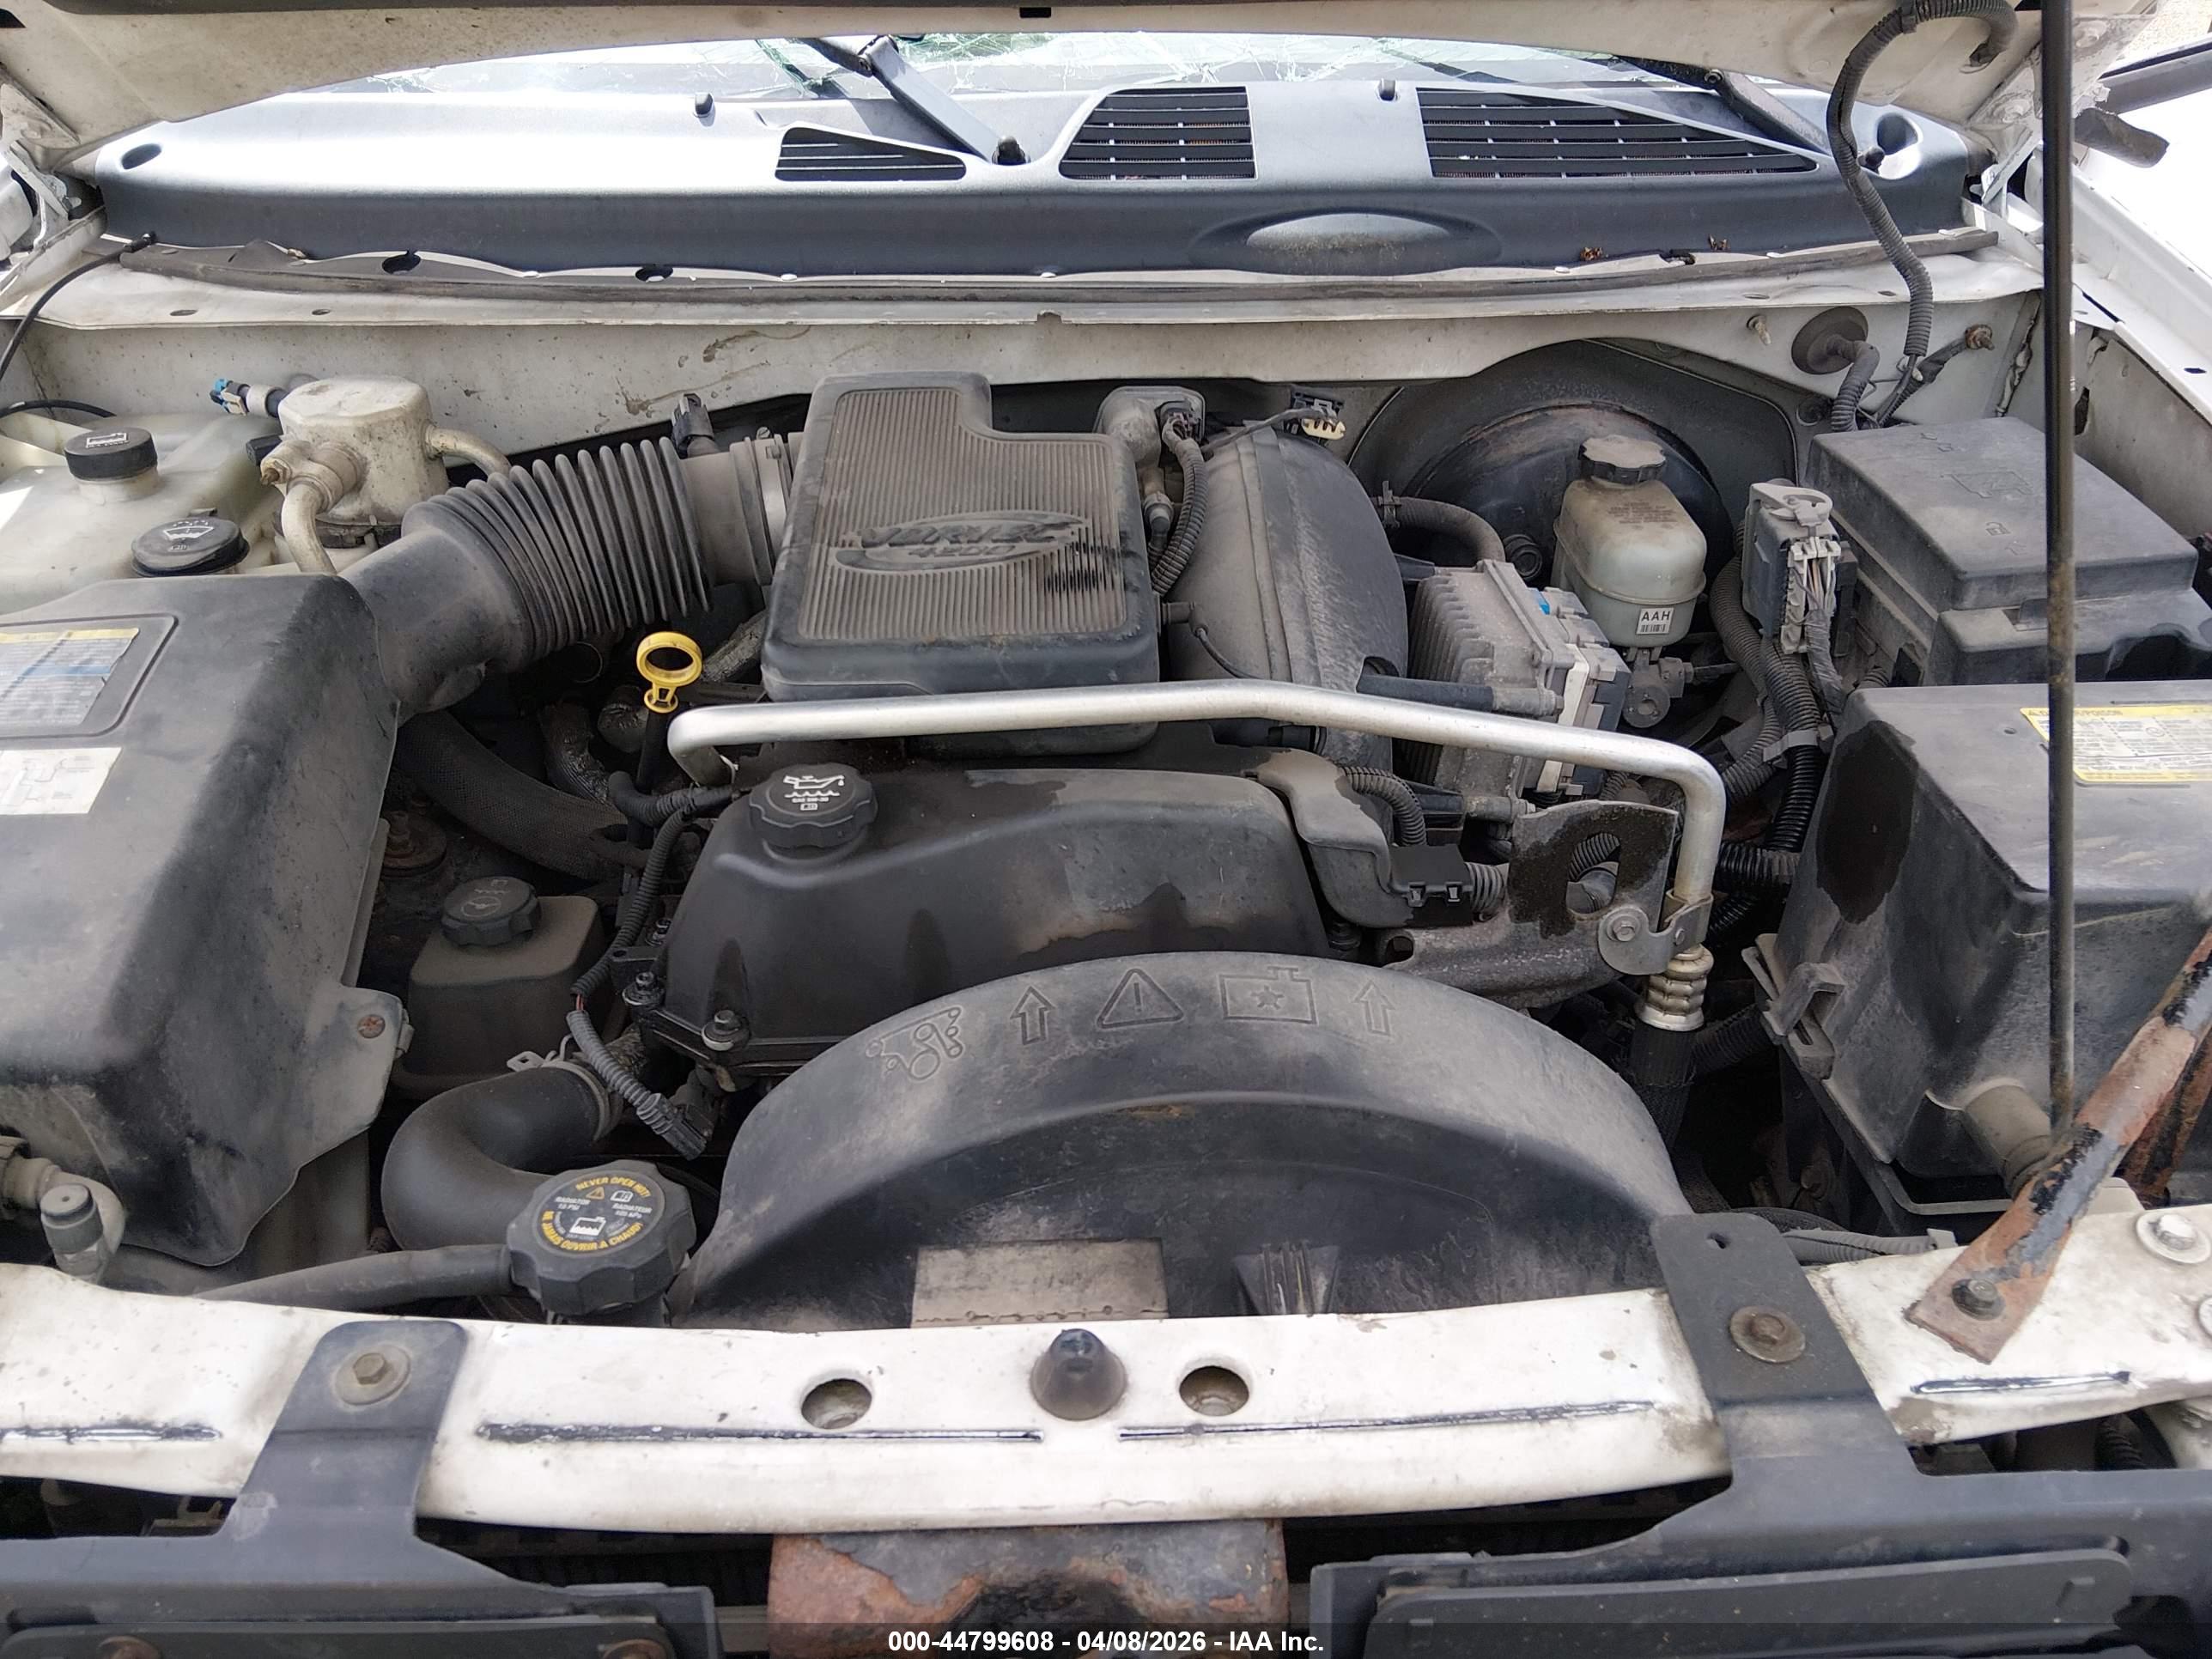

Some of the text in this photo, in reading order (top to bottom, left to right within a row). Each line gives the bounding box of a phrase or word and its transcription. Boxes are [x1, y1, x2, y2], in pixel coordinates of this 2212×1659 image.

[908, 544, 1016, 557] 4200
[1641, 611, 1671, 622] AAH
[575, 1176, 610, 1191] NEVER
[610, 1176, 637, 1188] OPEN
[555, 1196, 592, 1206] RADIATOR
[611, 1203, 653, 1213] RADIATEUR
[560, 1239, 599, 1251] OUVRIR
